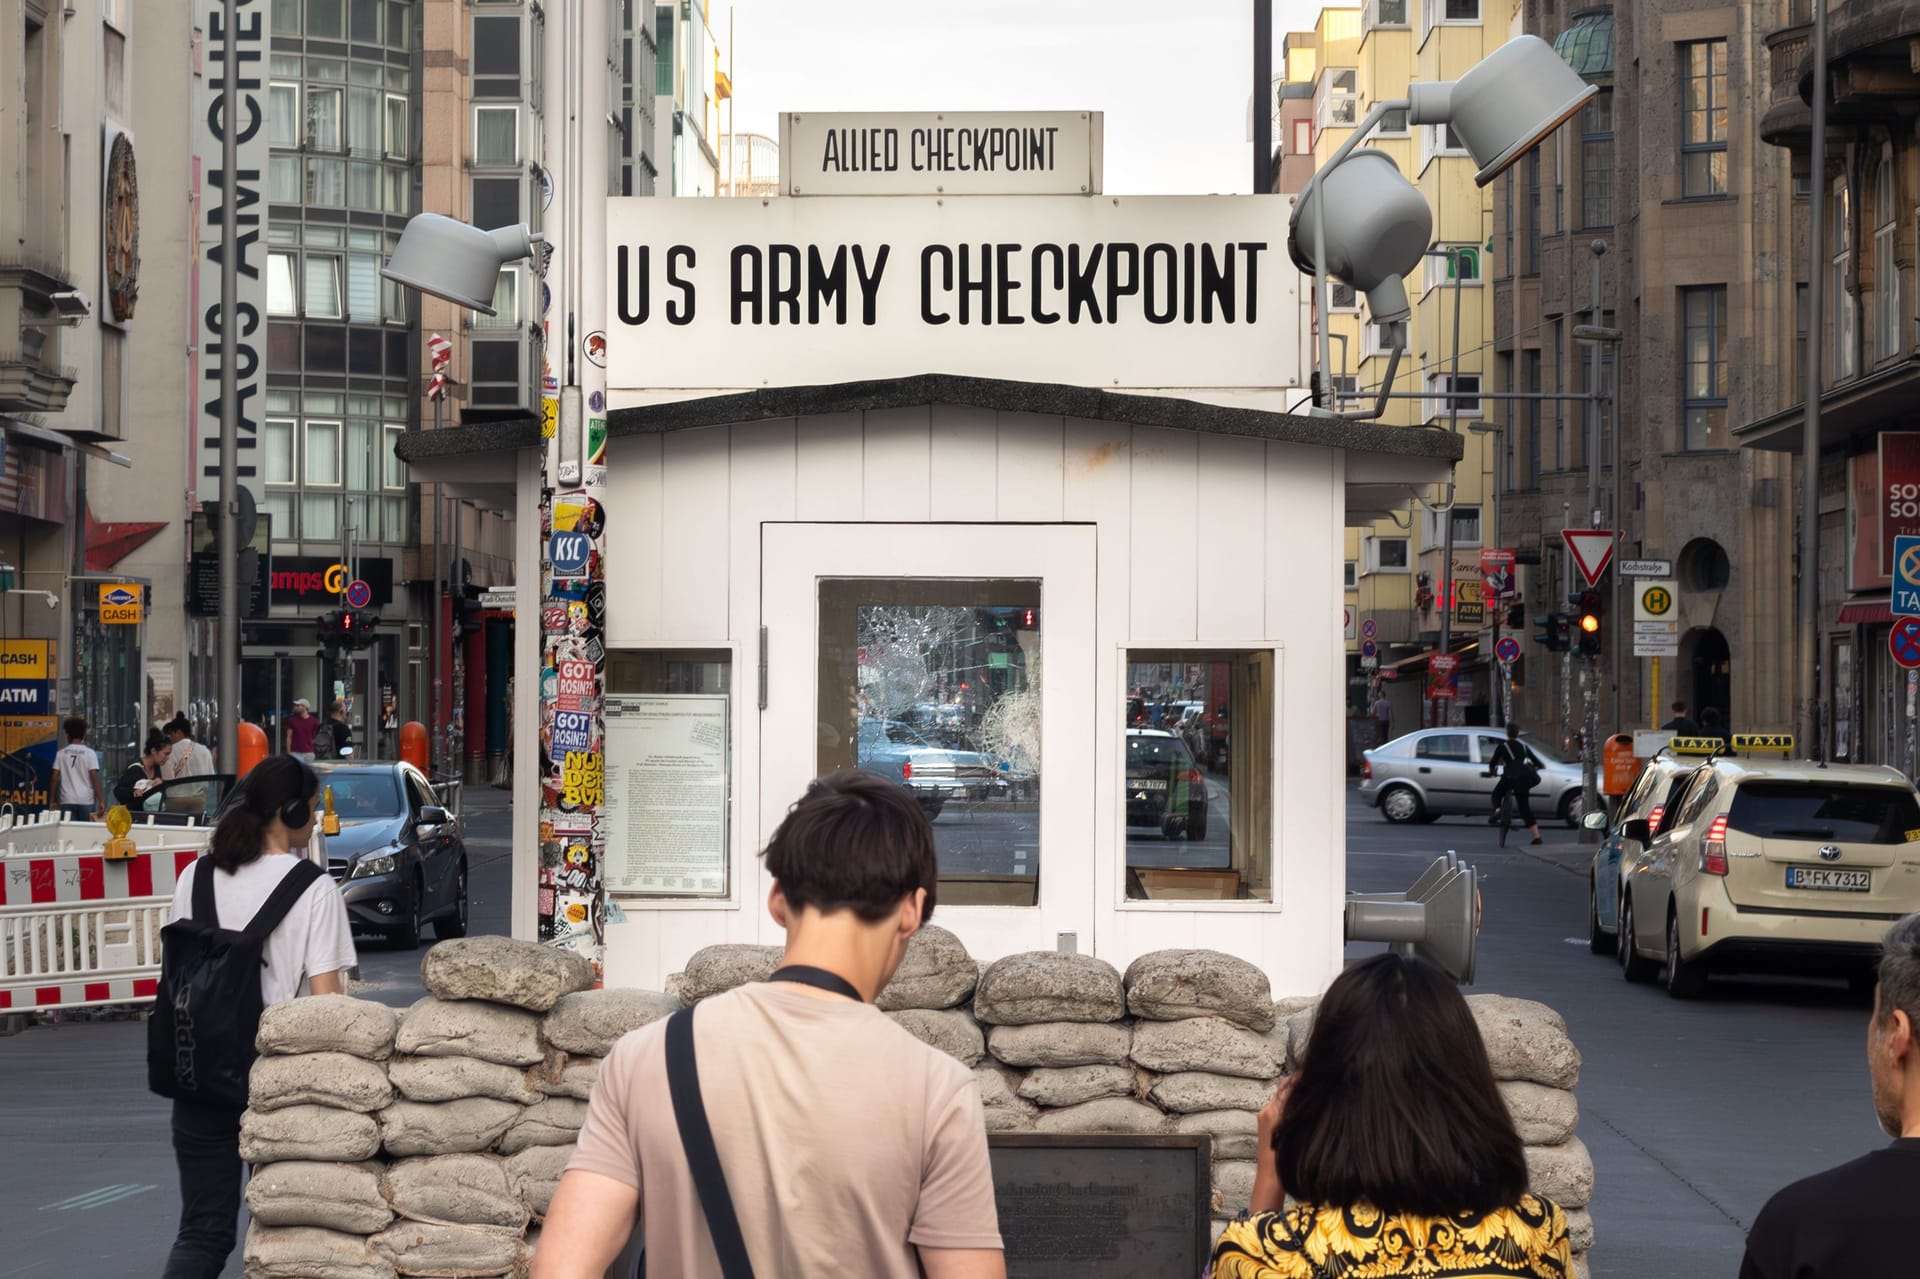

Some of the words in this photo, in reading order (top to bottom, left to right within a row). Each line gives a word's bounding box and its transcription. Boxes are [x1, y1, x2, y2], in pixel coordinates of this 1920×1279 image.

[208, 0, 261, 145] CHE
[823, 129, 898, 172] ALLIED
[911, 127, 1058, 172] CHECKPOINT
[207, 170, 260, 280] AM
[730, 244, 890, 326] ARMY
[920, 243, 1268, 326] CHECKPOINT
[205, 303, 259, 478] HAUS
[1890, 484, 1920, 500] SO
[1890, 502, 1920, 517] SO
[555, 537, 582, 561] KSC
[1622, 562, 1663, 574] Kochstraße
[1650, 593, 1664, 609] H
[103, 609, 136, 620] CASH
[0, 654, 37, 665] CASH
[562, 662, 593, 679] GOT
[0, 688, 37, 703] ATM
[560, 678, 593, 696] ROSIN??
[557, 713, 588, 730] GOT
[554, 729, 587, 747] ROSIN??
[1681, 739, 1717, 748] TAXI
[1742, 735, 1785, 745] TAXI
[70, 755, 77, 769] 7
[1795, 869, 1805, 884] B
[1812, 872, 1832, 886] FK
[1834, 873, 1868, 888] 7312
